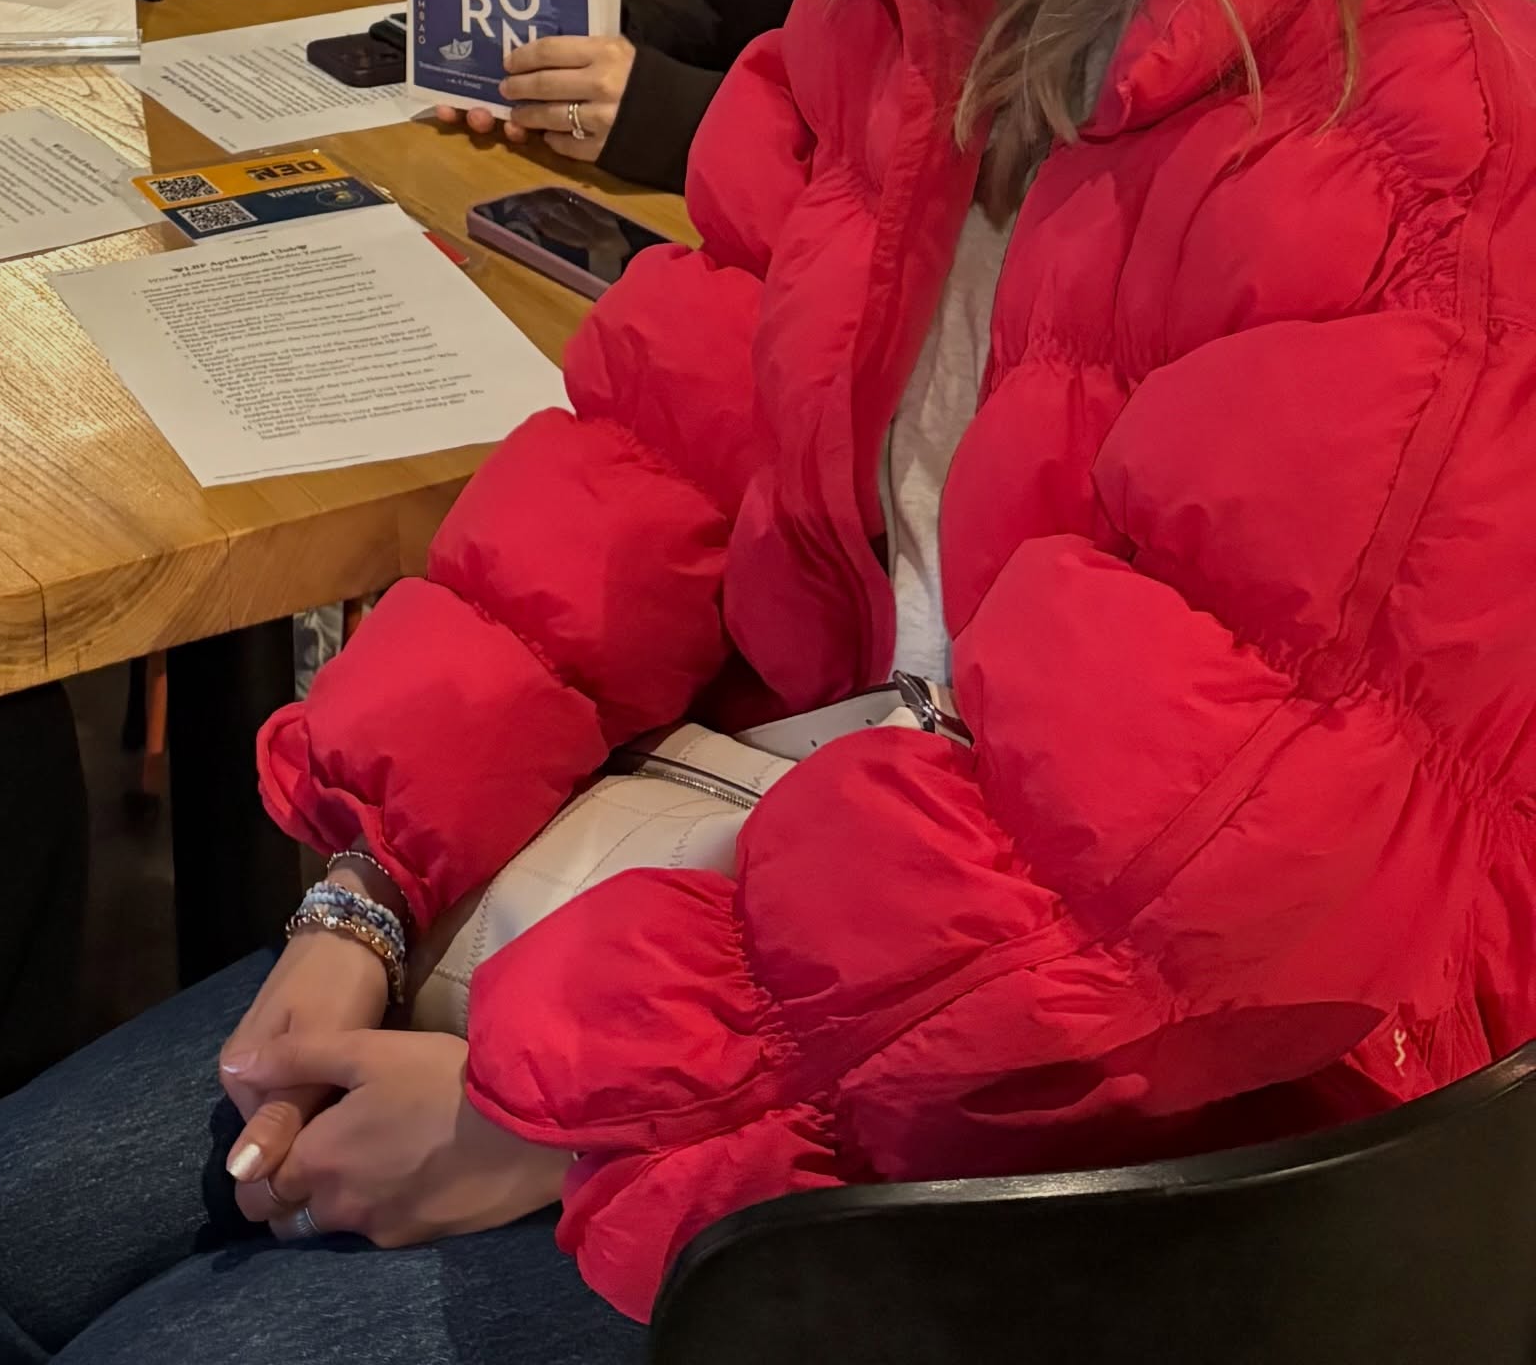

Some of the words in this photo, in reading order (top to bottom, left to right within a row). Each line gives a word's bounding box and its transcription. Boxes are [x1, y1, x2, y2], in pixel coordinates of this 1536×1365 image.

[245, 160, 325, 182] DEN
[207, 256, 239, 267] April
[238, 250, 270, 260] Book
